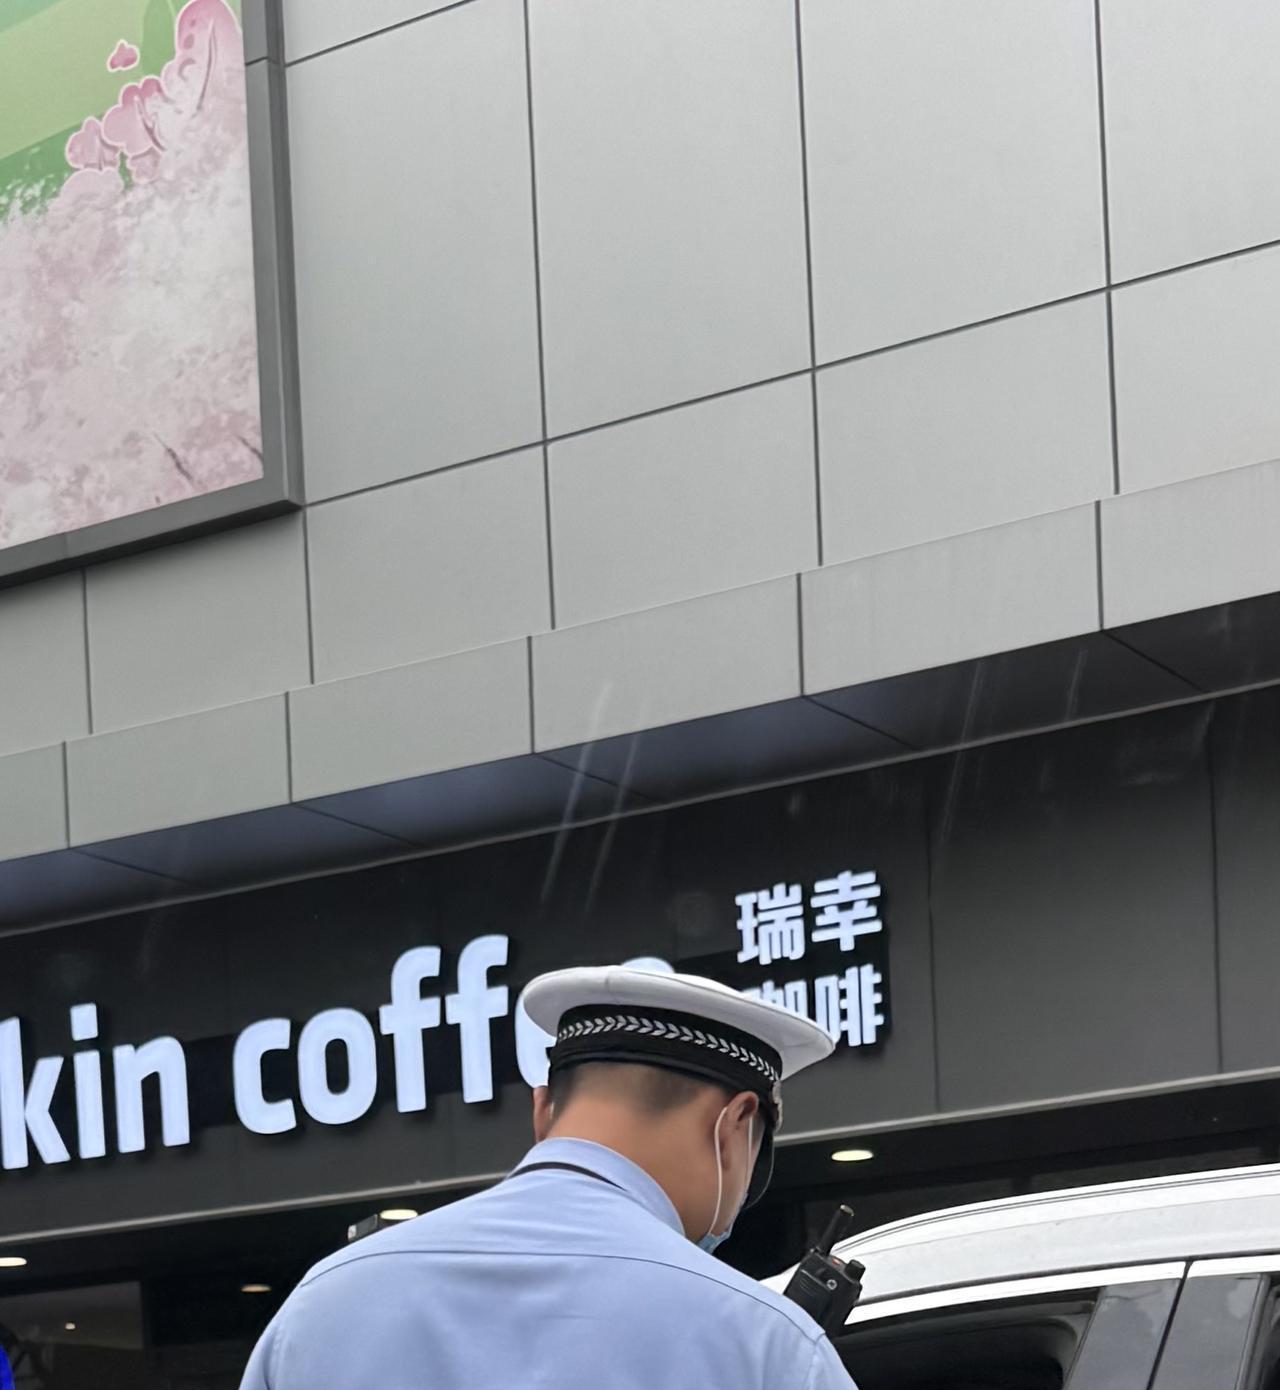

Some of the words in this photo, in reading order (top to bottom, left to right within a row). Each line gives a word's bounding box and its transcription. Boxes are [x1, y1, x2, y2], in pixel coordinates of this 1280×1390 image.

[735, 870, 882, 965] 瑞幸
[0, 1002, 190, 1170] kin
[232, 934, 676, 1135] coff
